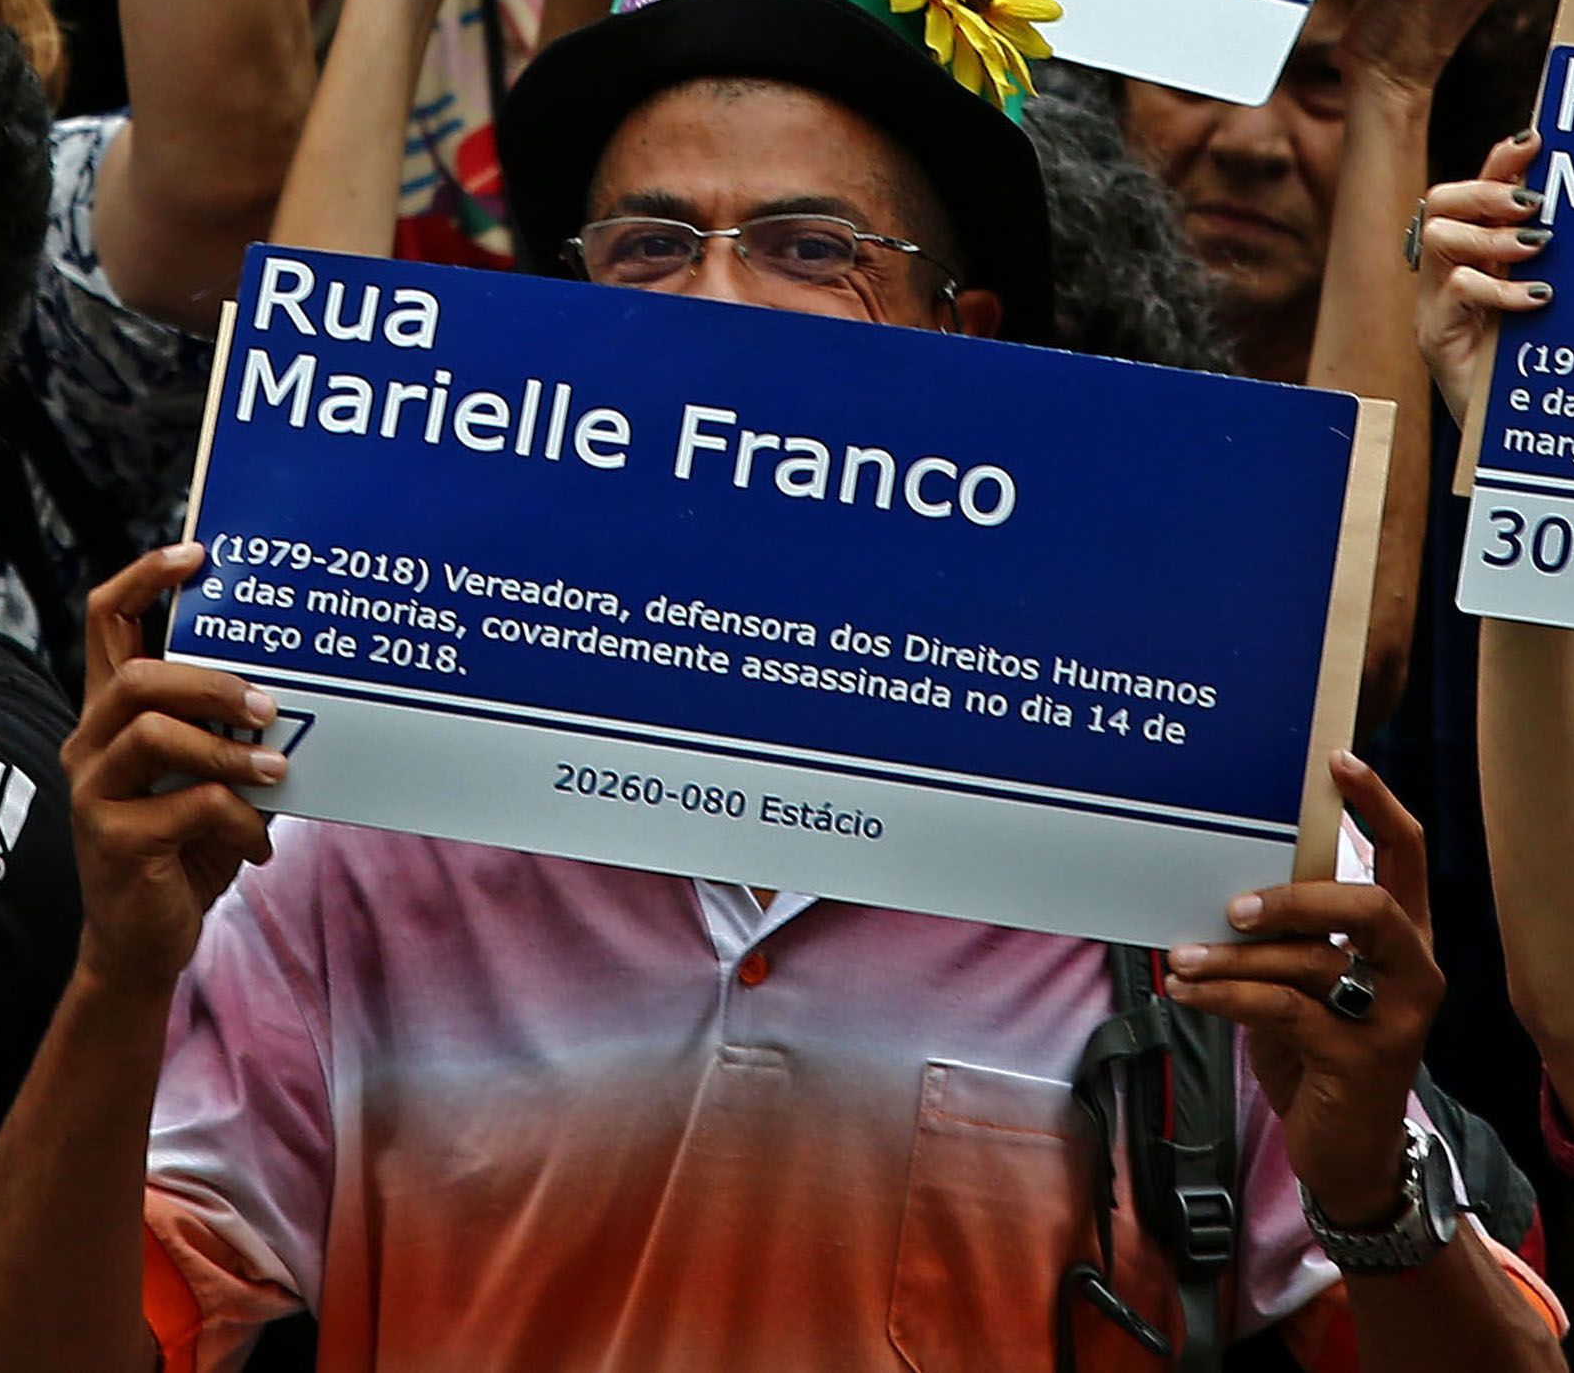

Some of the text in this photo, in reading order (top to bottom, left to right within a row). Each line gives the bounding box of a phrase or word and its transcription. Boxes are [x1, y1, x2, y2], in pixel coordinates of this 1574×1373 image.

[253, 258, 439, 349] Rua
[233, 346, 1016, 526] Marielle Franco
[1509, 388, 1531, 412] e
[193, 614, 467, 676] março de 2018.
[200, 574, 1187, 746] e das minorias, covardemente assassinada no dia 14 de
[209, 530, 1218, 709] (1979-2018) Vereadora, defensora dos Direitos Humanos
[552, 762, 884, 840] 20260-080 Estácio
